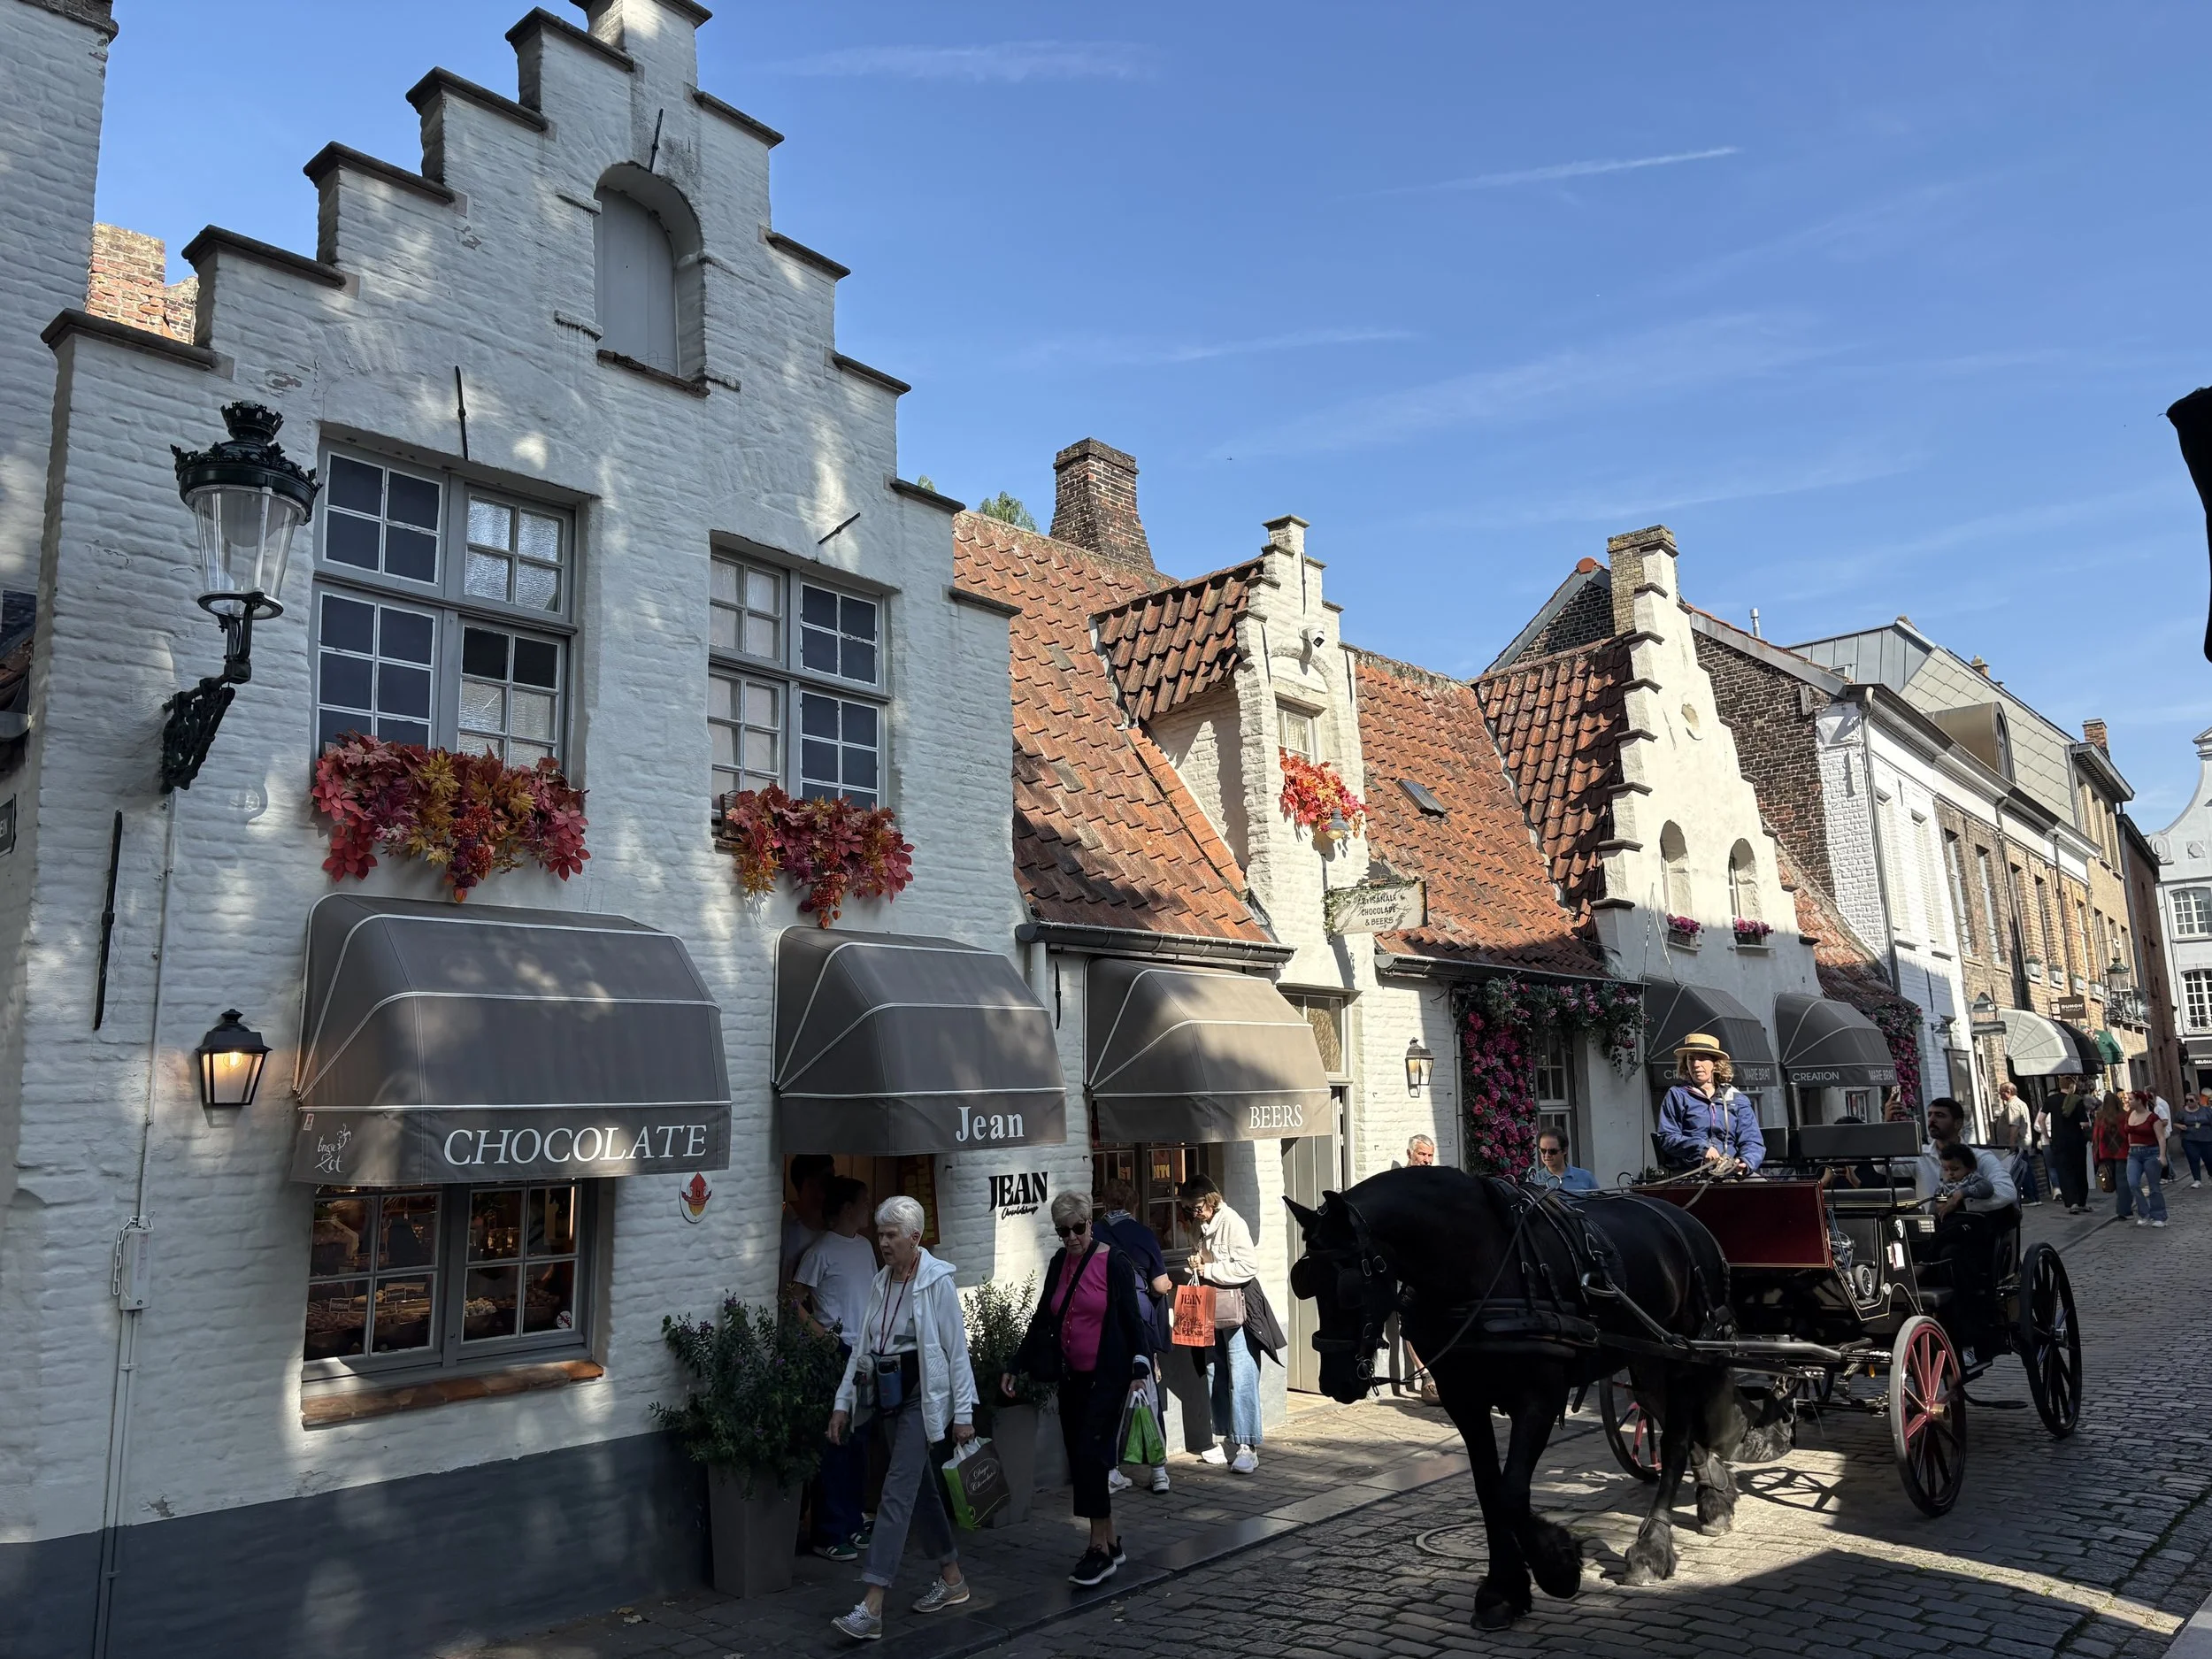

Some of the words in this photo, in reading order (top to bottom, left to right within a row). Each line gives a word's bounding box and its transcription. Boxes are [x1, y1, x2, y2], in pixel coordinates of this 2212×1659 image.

[1361, 905, 1396, 917] CHOCOLADE
[1371, 916, 1394, 926] BEERS
[1792, 1071, 1839, 1082] CREATION
[956, 1105, 1025, 1142] Jean
[1248, 1103, 1303, 1130] BEERS
[443, 1124, 708, 1166] CHOCOLATE
[988, 1171, 1048, 1212] JEAN
[1181, 1294, 1202, 1306] JEAN
